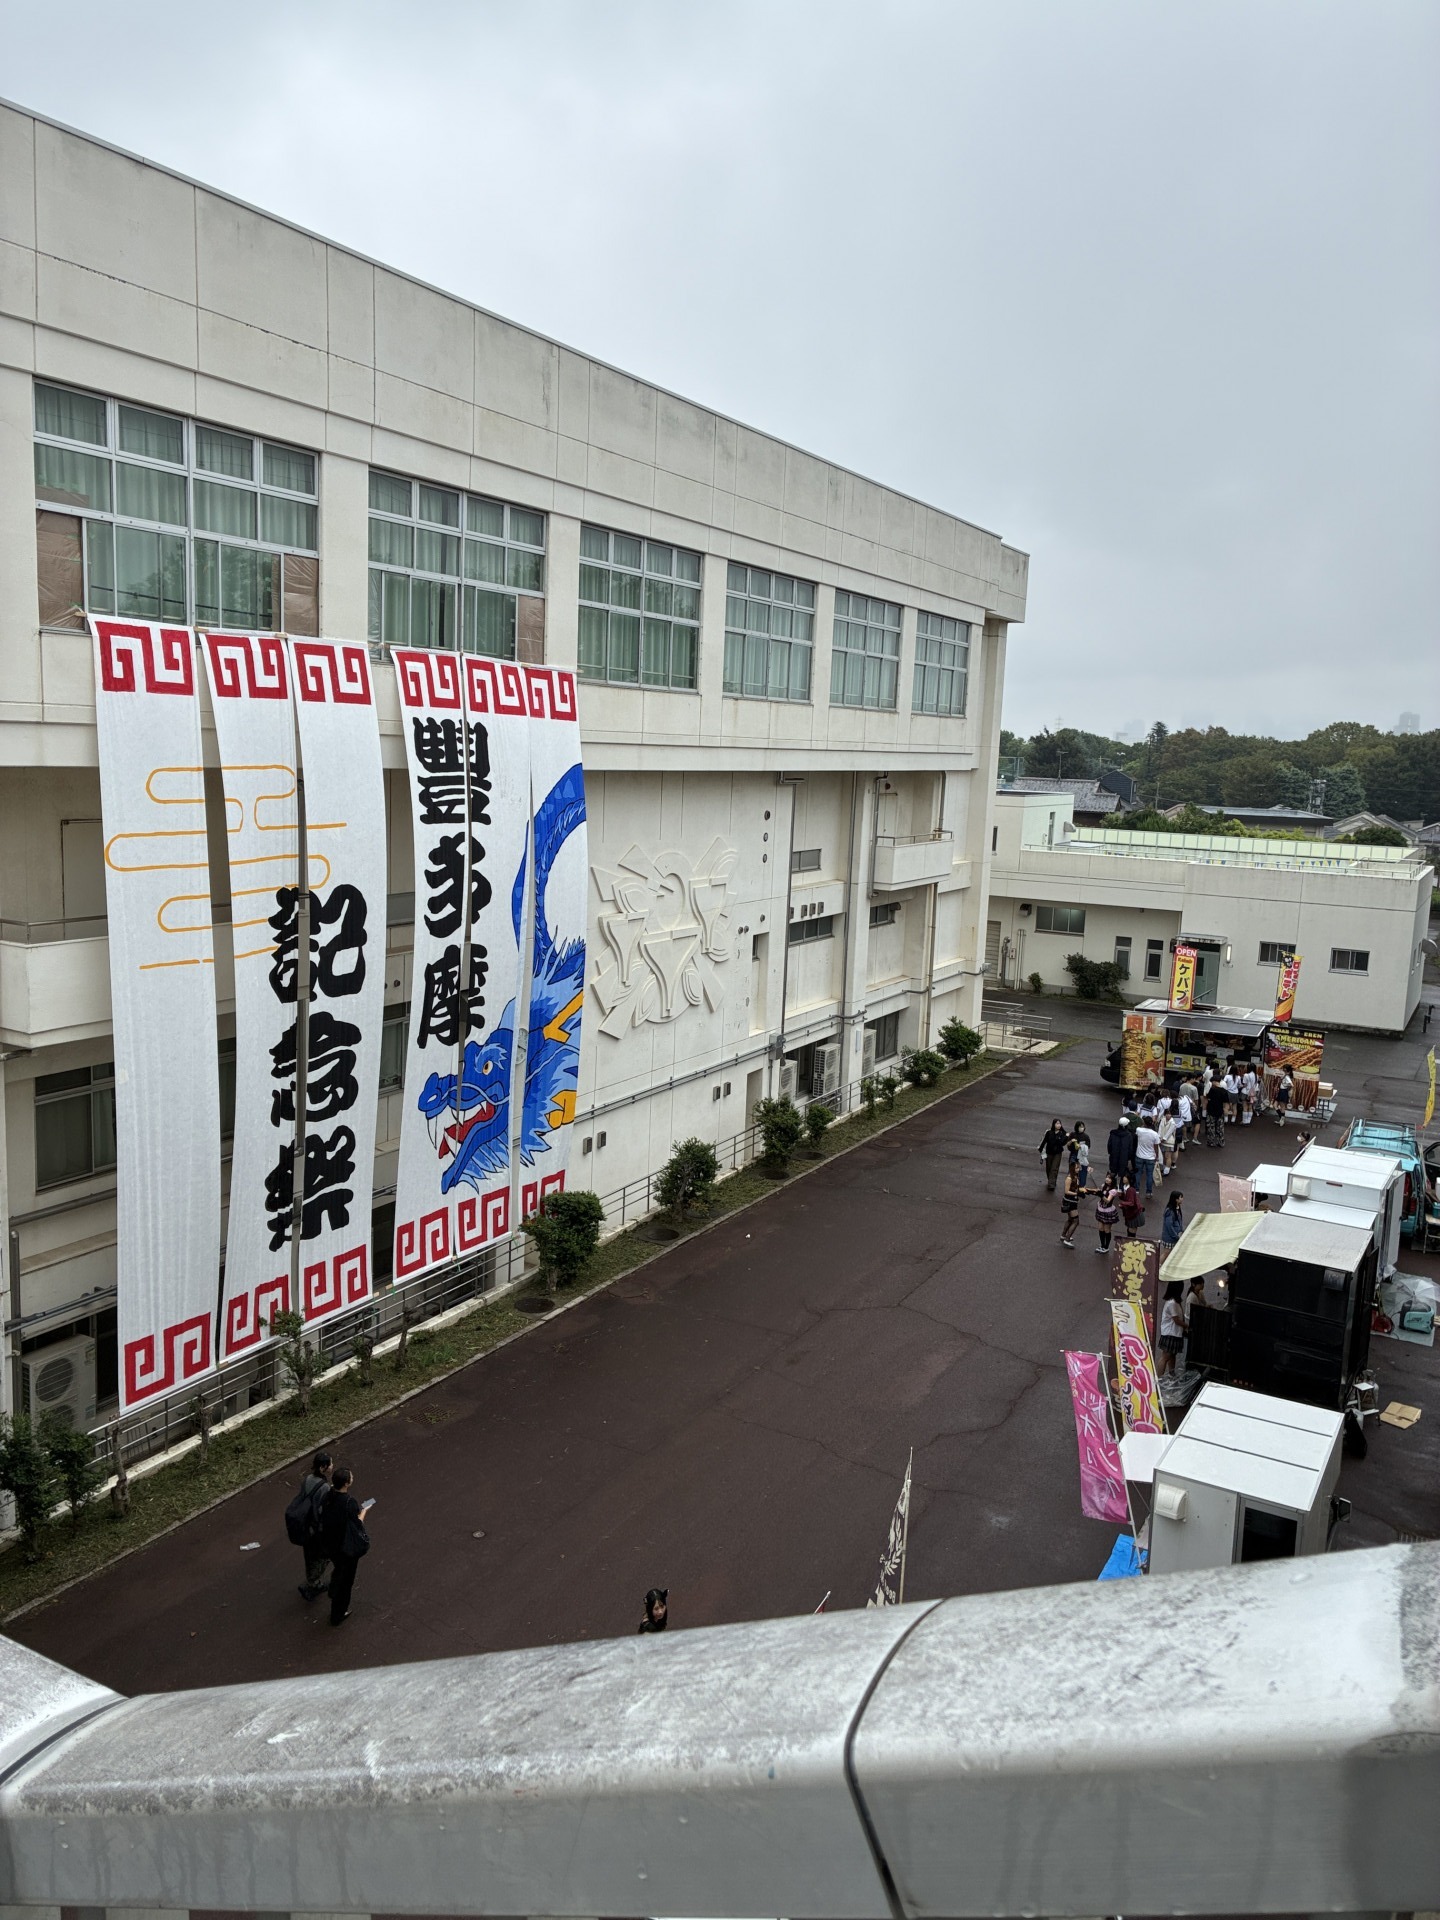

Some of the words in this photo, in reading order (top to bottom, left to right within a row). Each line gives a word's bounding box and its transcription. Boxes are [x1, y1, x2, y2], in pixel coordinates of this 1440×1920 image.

[1176, 947, 1197, 957] OPEN
[1176, 963, 1190, 1001] ケバブ
[1276, 1034, 1316, 1045] AMERICAN
